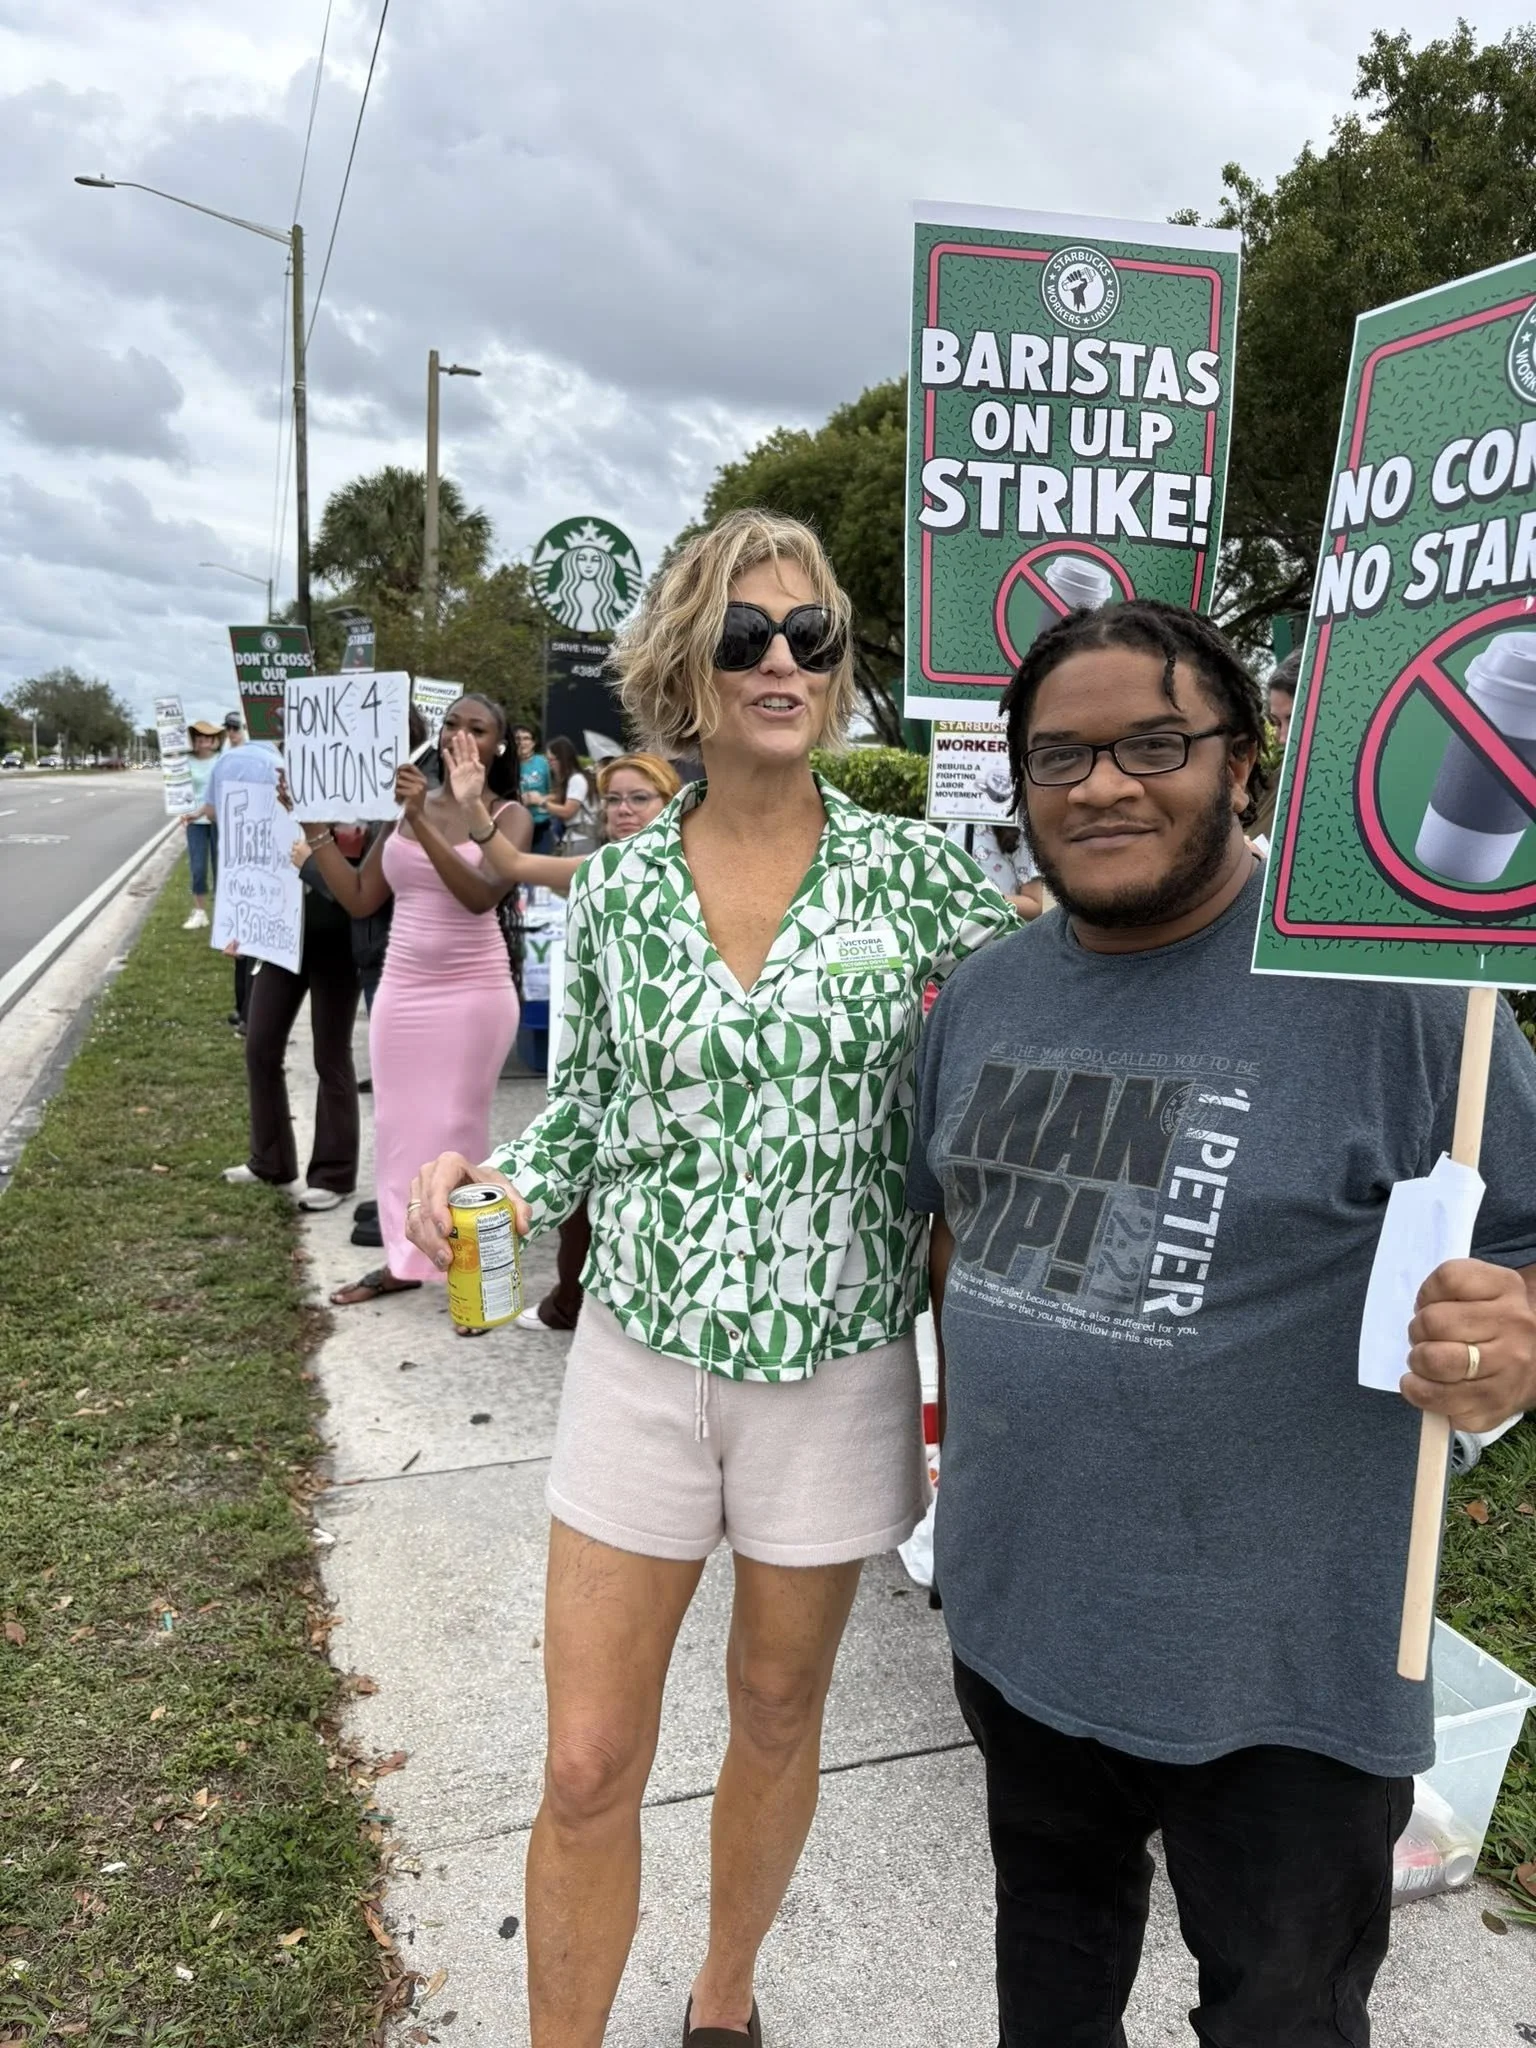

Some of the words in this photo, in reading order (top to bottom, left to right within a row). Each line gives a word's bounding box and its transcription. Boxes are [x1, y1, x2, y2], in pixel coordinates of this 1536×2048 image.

[1053, 251, 1111, 277] STARBUCKS
[1047, 284, 1081, 325] WORKERS
[1090, 290, 1115, 322] UNITED
[921, 328, 1220, 406] BARISTAS
[1515, 348, 1536, 393] WORK
[972, 401, 1052, 454] ON
[1070, 407, 1174, 459] ULP
[918, 458, 1213, 545] STRIKE!
[1330, 456, 1413, 530] NO
[1315, 544, 1391, 618] NO
[235, 652, 270, 666] DON'T
[273, 653, 311, 667] CROSS
[261, 667, 287, 681] OUR
[240, 681, 285, 696] PICKET
[287, 681, 353, 738] HONK
[361, 680, 383, 738] 4
[936, 773, 976, 781] FIGHTING
[936, 781, 964, 789] LABOR
[937, 763, 973, 771] REBUILD
[974, 763, 981, 771] A
[935, 790, 983, 799] MOVEMENT
[839, 944, 886, 957] DOYLE
[843, 938, 882, 946] VICTORIA
[1070, 1047, 1103, 1063] GOD
[1108, 1051, 1168, 1068] CALLED
[1174, 1053, 1209, 1068] YOU
[1209, 1055, 1230, 1071] TO
[1235, 1059, 1260, 1075] BE
[949, 1061, 1196, 1191] MAN
[1142, 1127, 1240, 1317] PETER
[1007, 1302, 1018, 1310] so
[1018, 1303, 1036, 1318] that
[1036, 1310, 1053, 1321] you
[1054, 1315, 1078, 1330] might
[1080, 1320, 1108, 1336] follow
[1112, 1327, 1122, 1340] in
[1125, 1331, 1140, 1343] his
[1026, 1291, 1060, 1310] because
[1061, 1302, 1087, 1319] Christ
[1089, 1311, 1111, 1323] also
[1113, 1318, 1156, 1332] suffered
[1159, 1324, 1174, 1334] for
